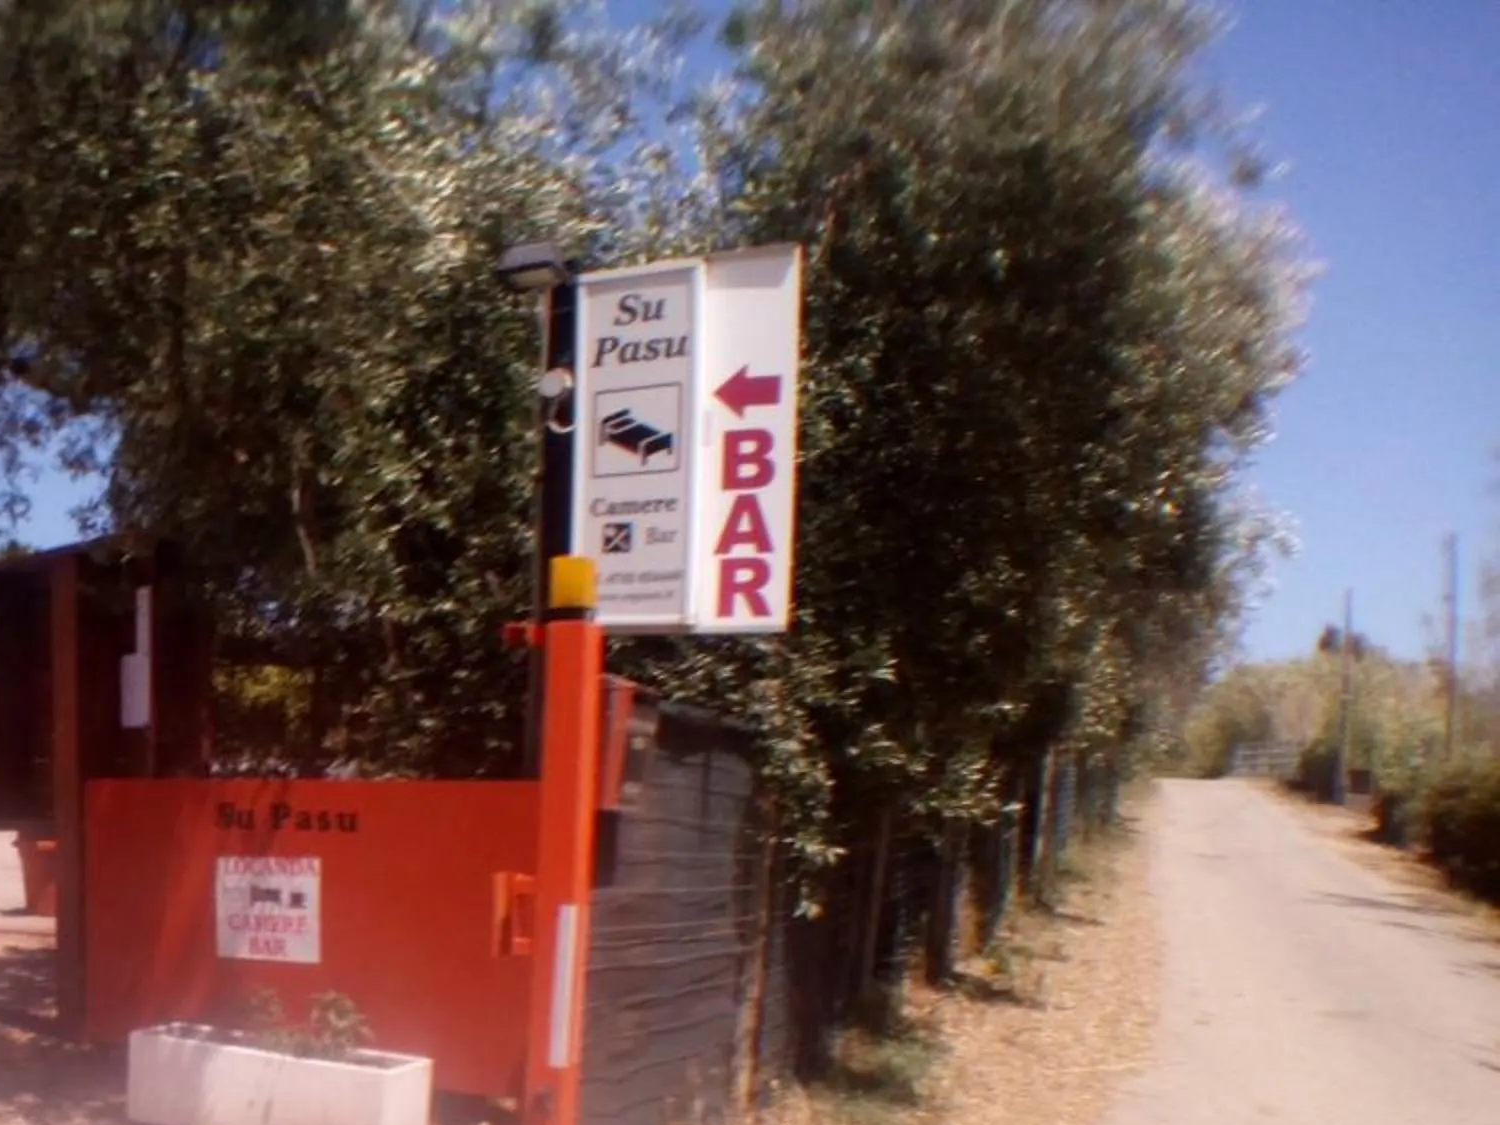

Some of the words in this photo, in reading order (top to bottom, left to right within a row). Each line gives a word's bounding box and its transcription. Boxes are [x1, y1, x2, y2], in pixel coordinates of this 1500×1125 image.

[613, 294, 665, 325] Su
[591, 334, 688, 368] Pasu
[589, 497, 678, 517] Camere
[713, 428, 775, 618] BAR
[216, 802, 254, 830] Su
[272, 803, 357, 832] Pasu
[249, 937, 287, 957] BAR
